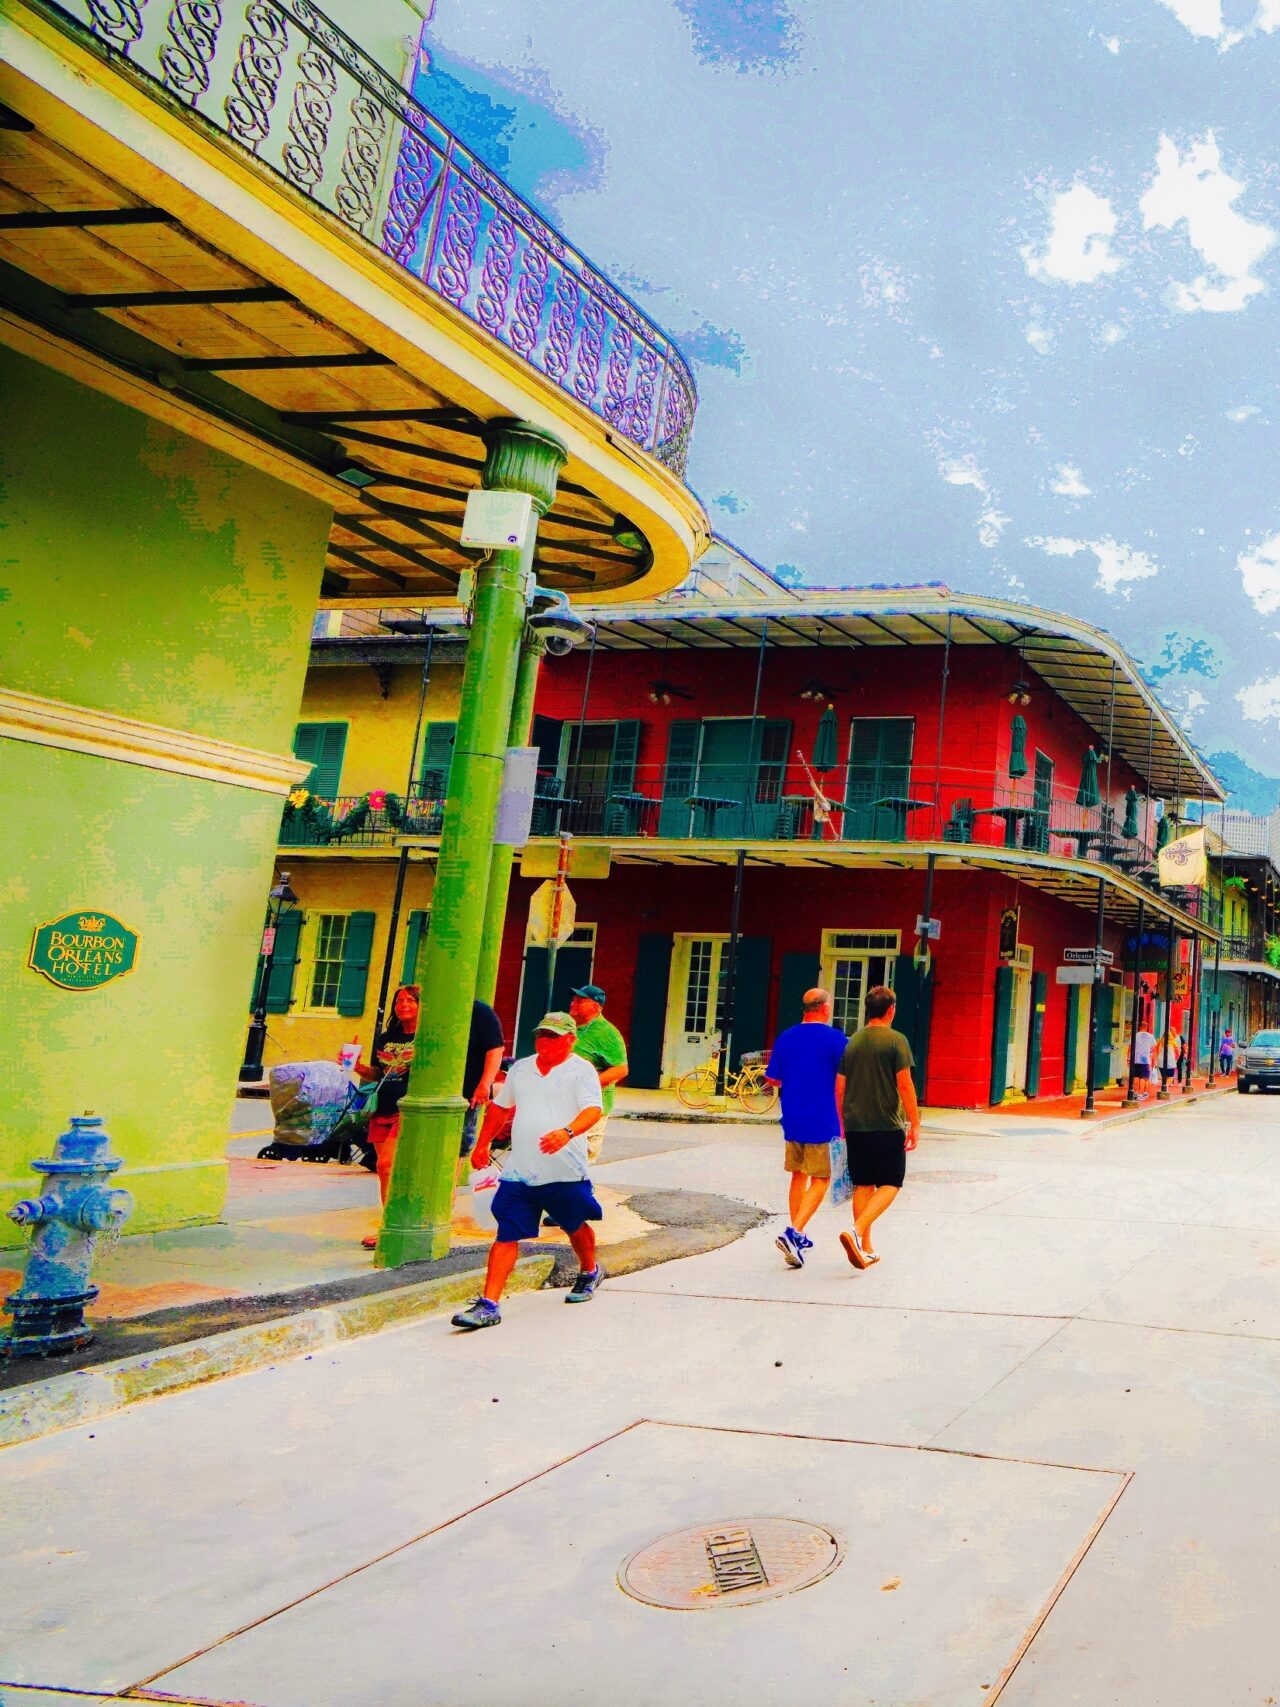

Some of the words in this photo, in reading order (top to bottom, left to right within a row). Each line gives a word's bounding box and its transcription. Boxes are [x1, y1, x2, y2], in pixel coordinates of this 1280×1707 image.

[50, 931, 125, 950] BOURBON
[47, 945, 123, 965] ORLEANS
[52, 961, 113, 976] HOTEL
